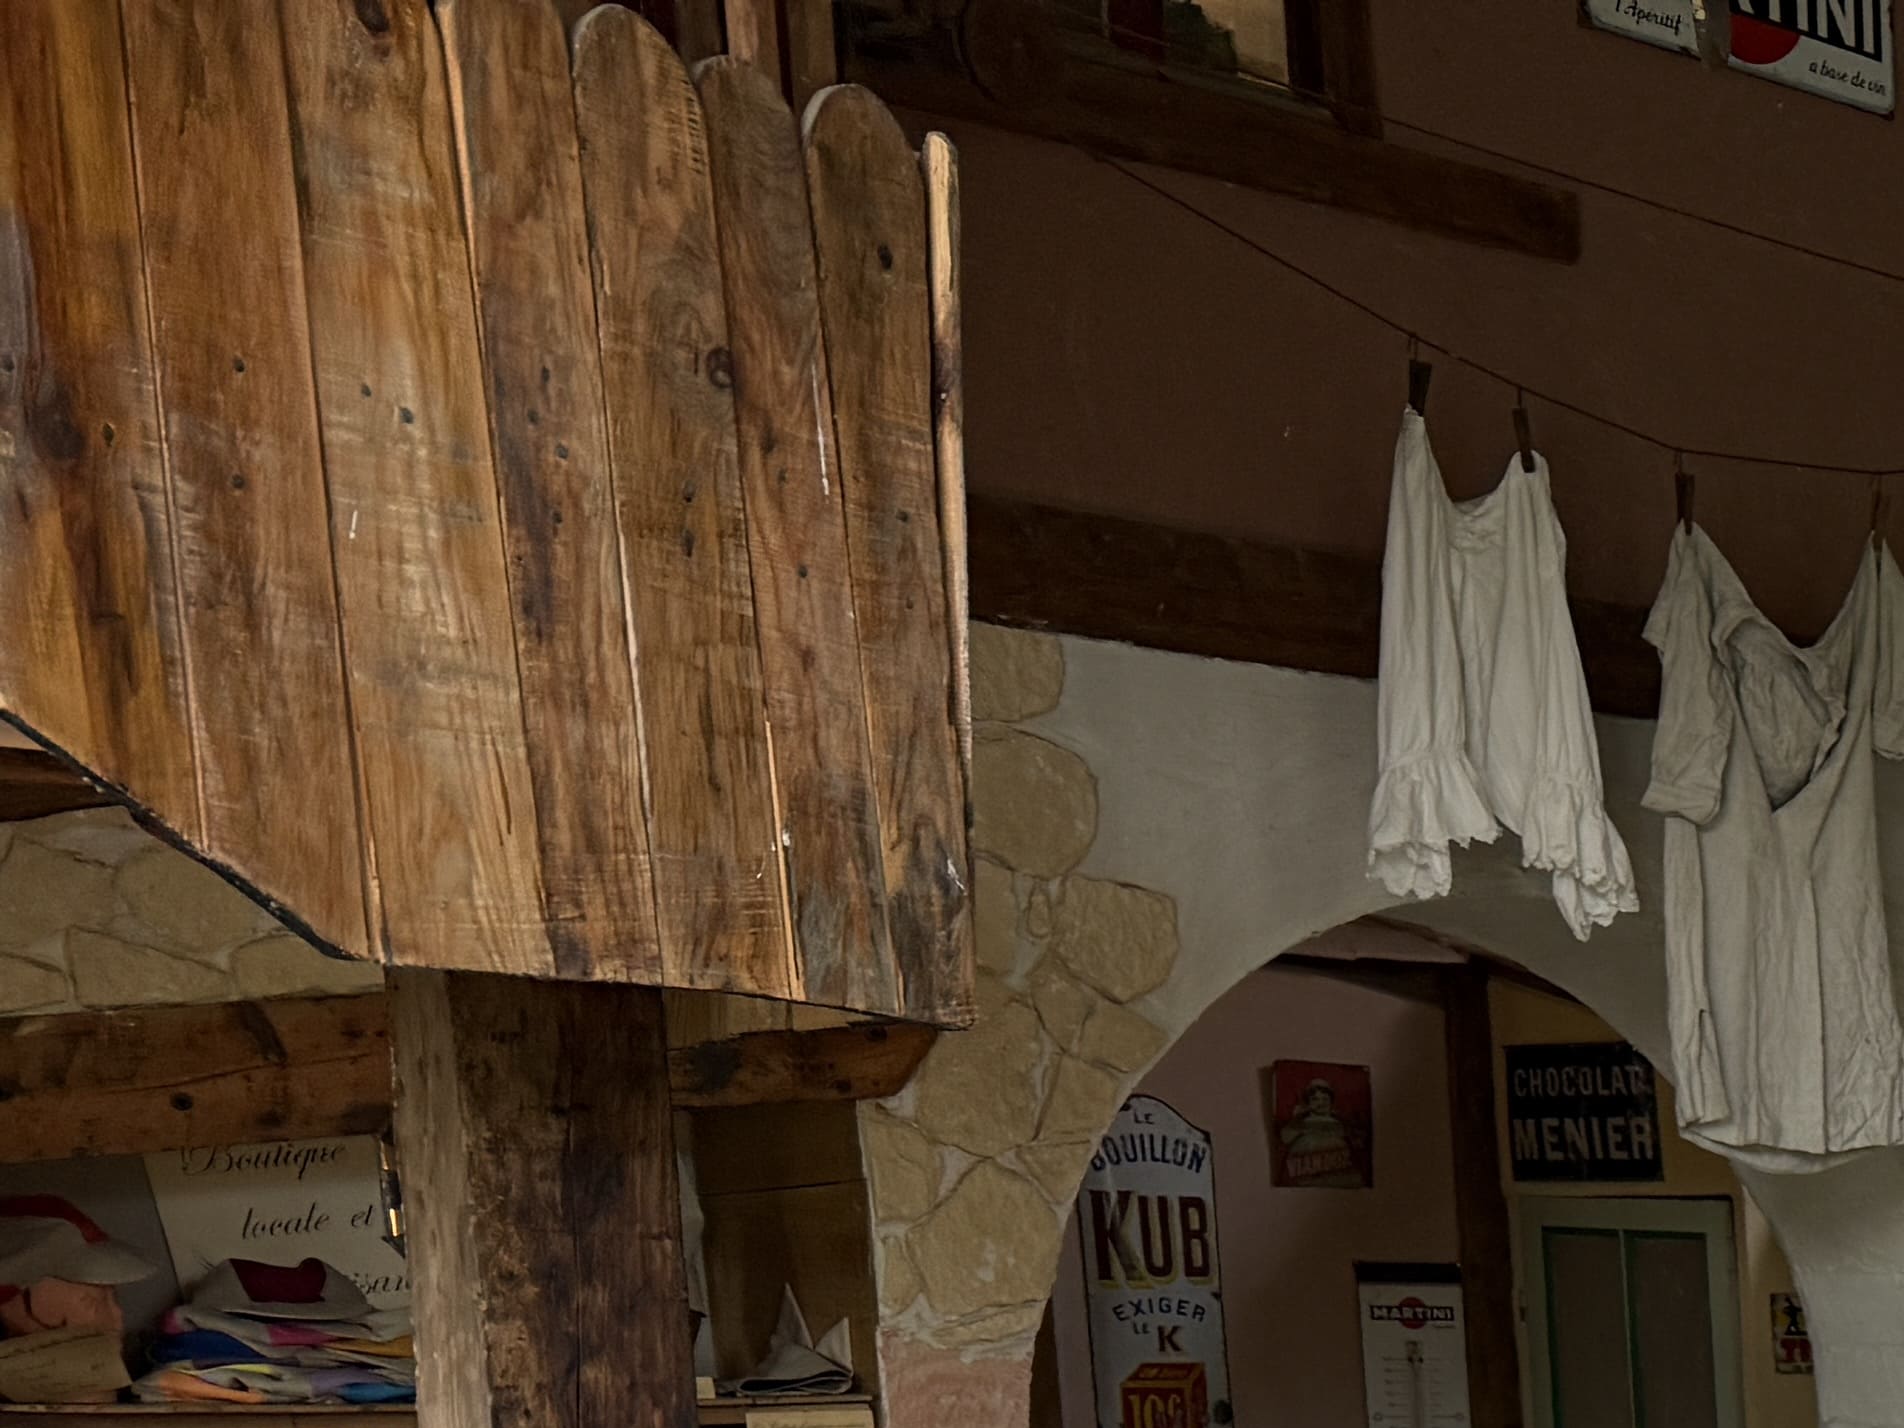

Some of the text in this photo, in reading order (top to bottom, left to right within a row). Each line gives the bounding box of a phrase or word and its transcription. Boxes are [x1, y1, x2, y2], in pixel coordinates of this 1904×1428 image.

[1514, 1063, 1654, 1098] CHOCOLAT
[1134, 1110, 1155, 1125] LE
[1512, 1116, 1654, 1161] MENIER
[241, 1201, 374, 1241] locale et
[1089, 1189, 1212, 1282] KUB
[1111, 1296, 1207, 1323] EXIGER
[1370, 1305, 1455, 1322] MARTINI
[1156, 1324, 1184, 1353] K
